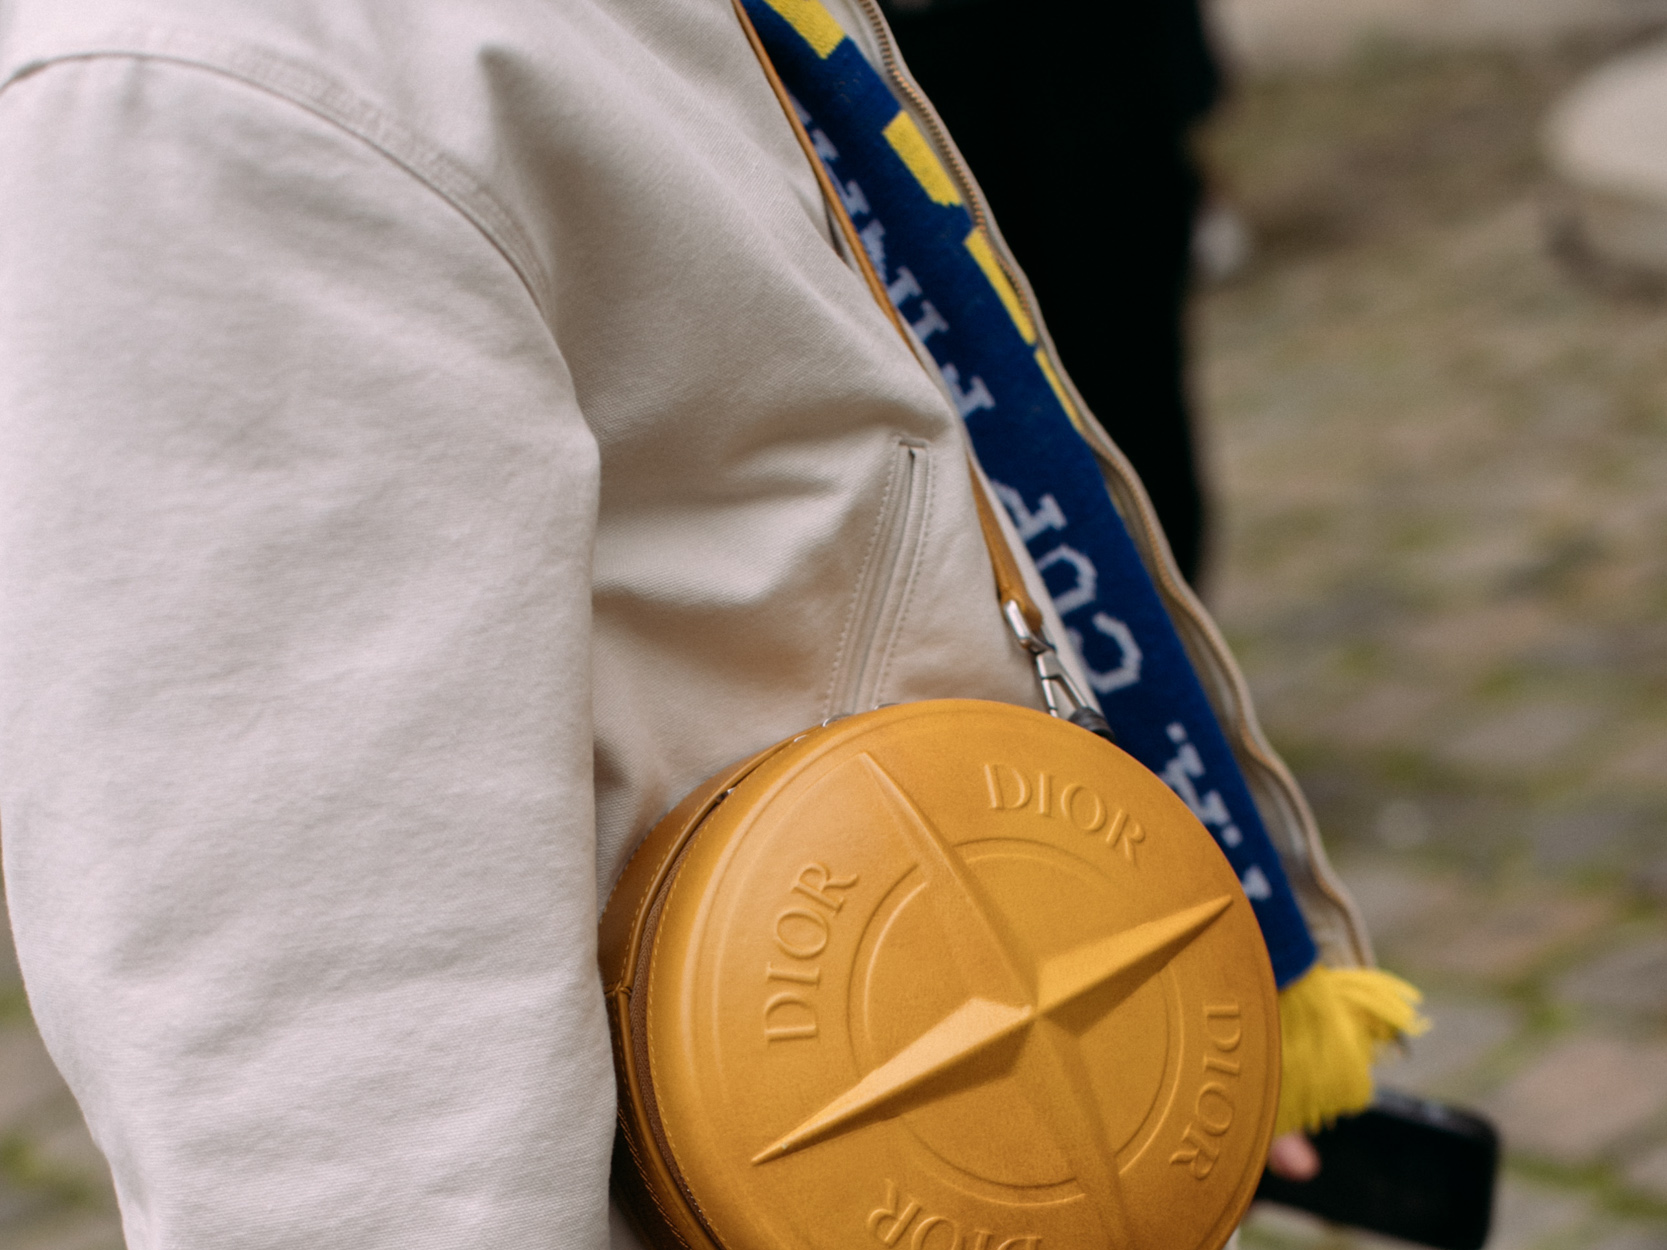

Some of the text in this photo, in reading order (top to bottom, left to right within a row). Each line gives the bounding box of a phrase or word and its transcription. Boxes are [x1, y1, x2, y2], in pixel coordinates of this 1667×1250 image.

[787, 88, 996, 419] FIN
[990, 479, 1143, 694] CUP
[983, 763, 1146, 867] DIOR
[766, 860, 860, 1046] DIOR
[1169, 999, 1242, 1182] DIOR
